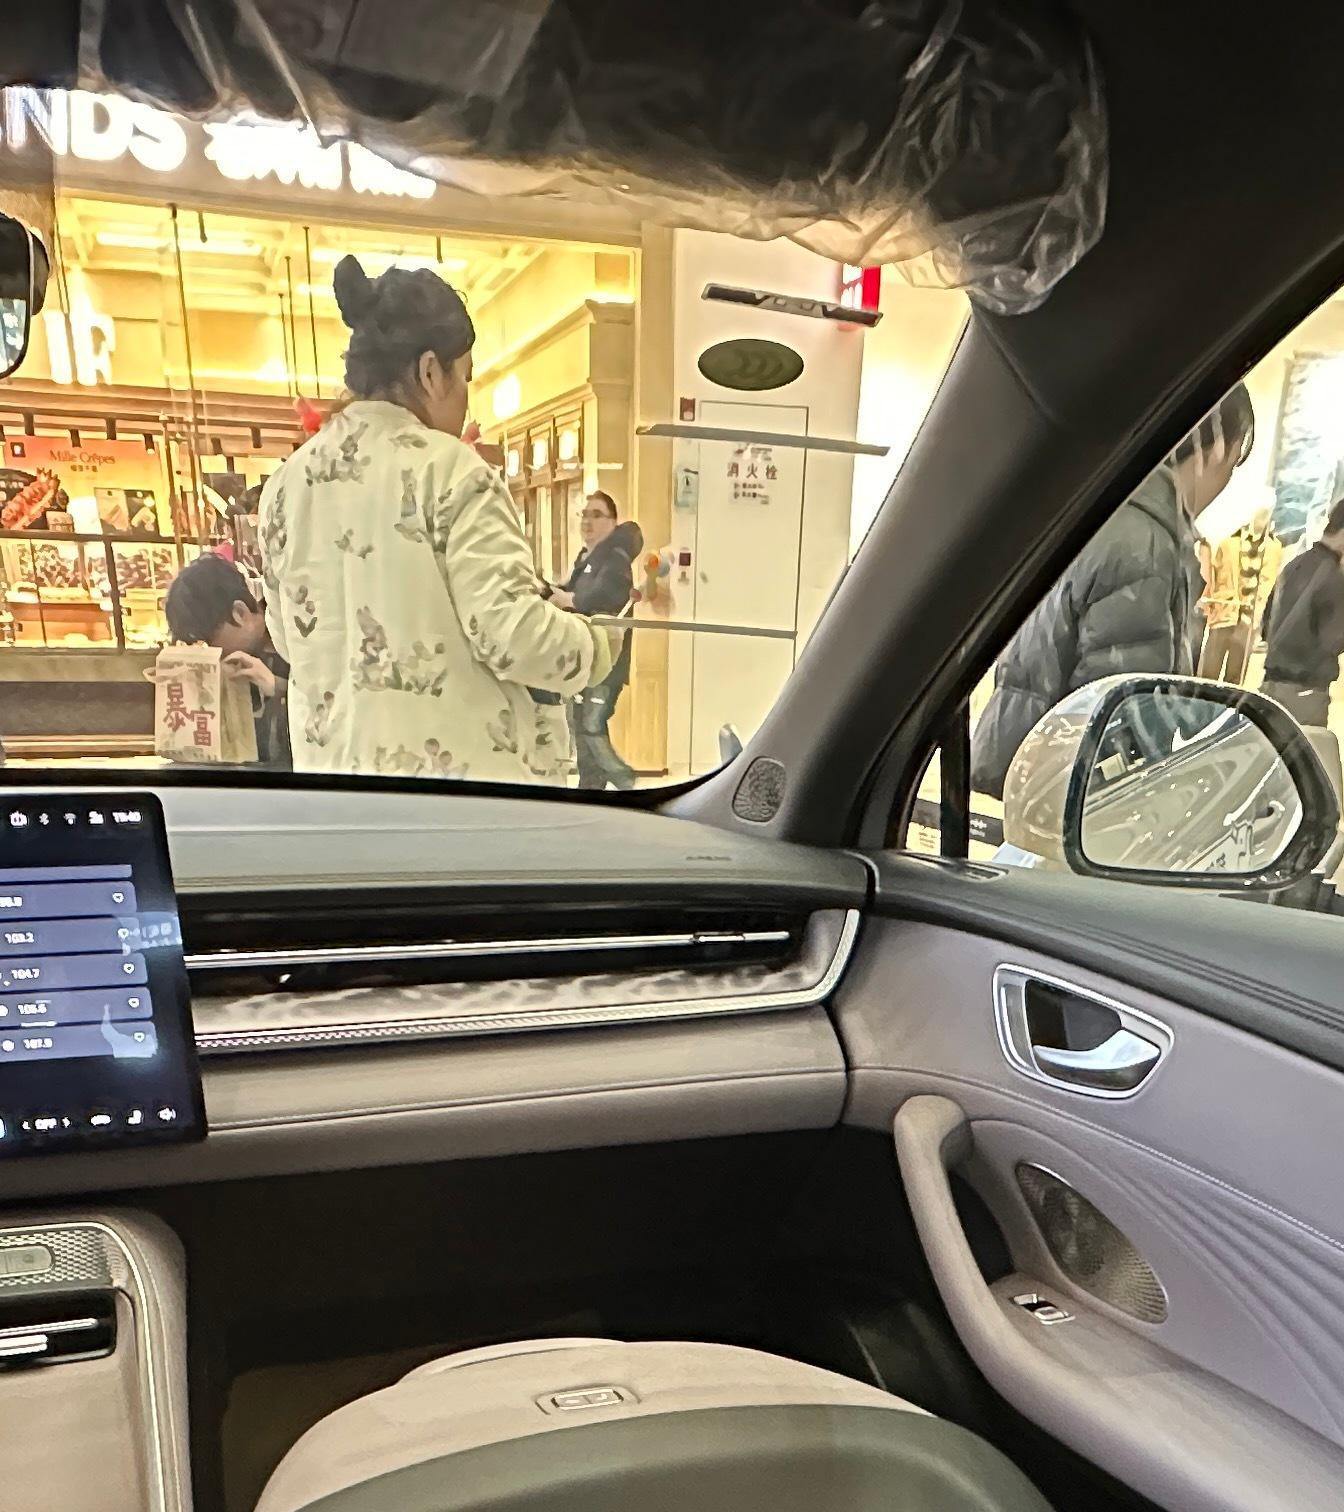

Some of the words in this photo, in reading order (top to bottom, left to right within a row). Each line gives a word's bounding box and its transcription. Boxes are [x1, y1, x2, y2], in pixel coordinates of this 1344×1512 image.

[726, 461, 778, 481] 消火栓
[163, 682, 216, 748] 暴富
